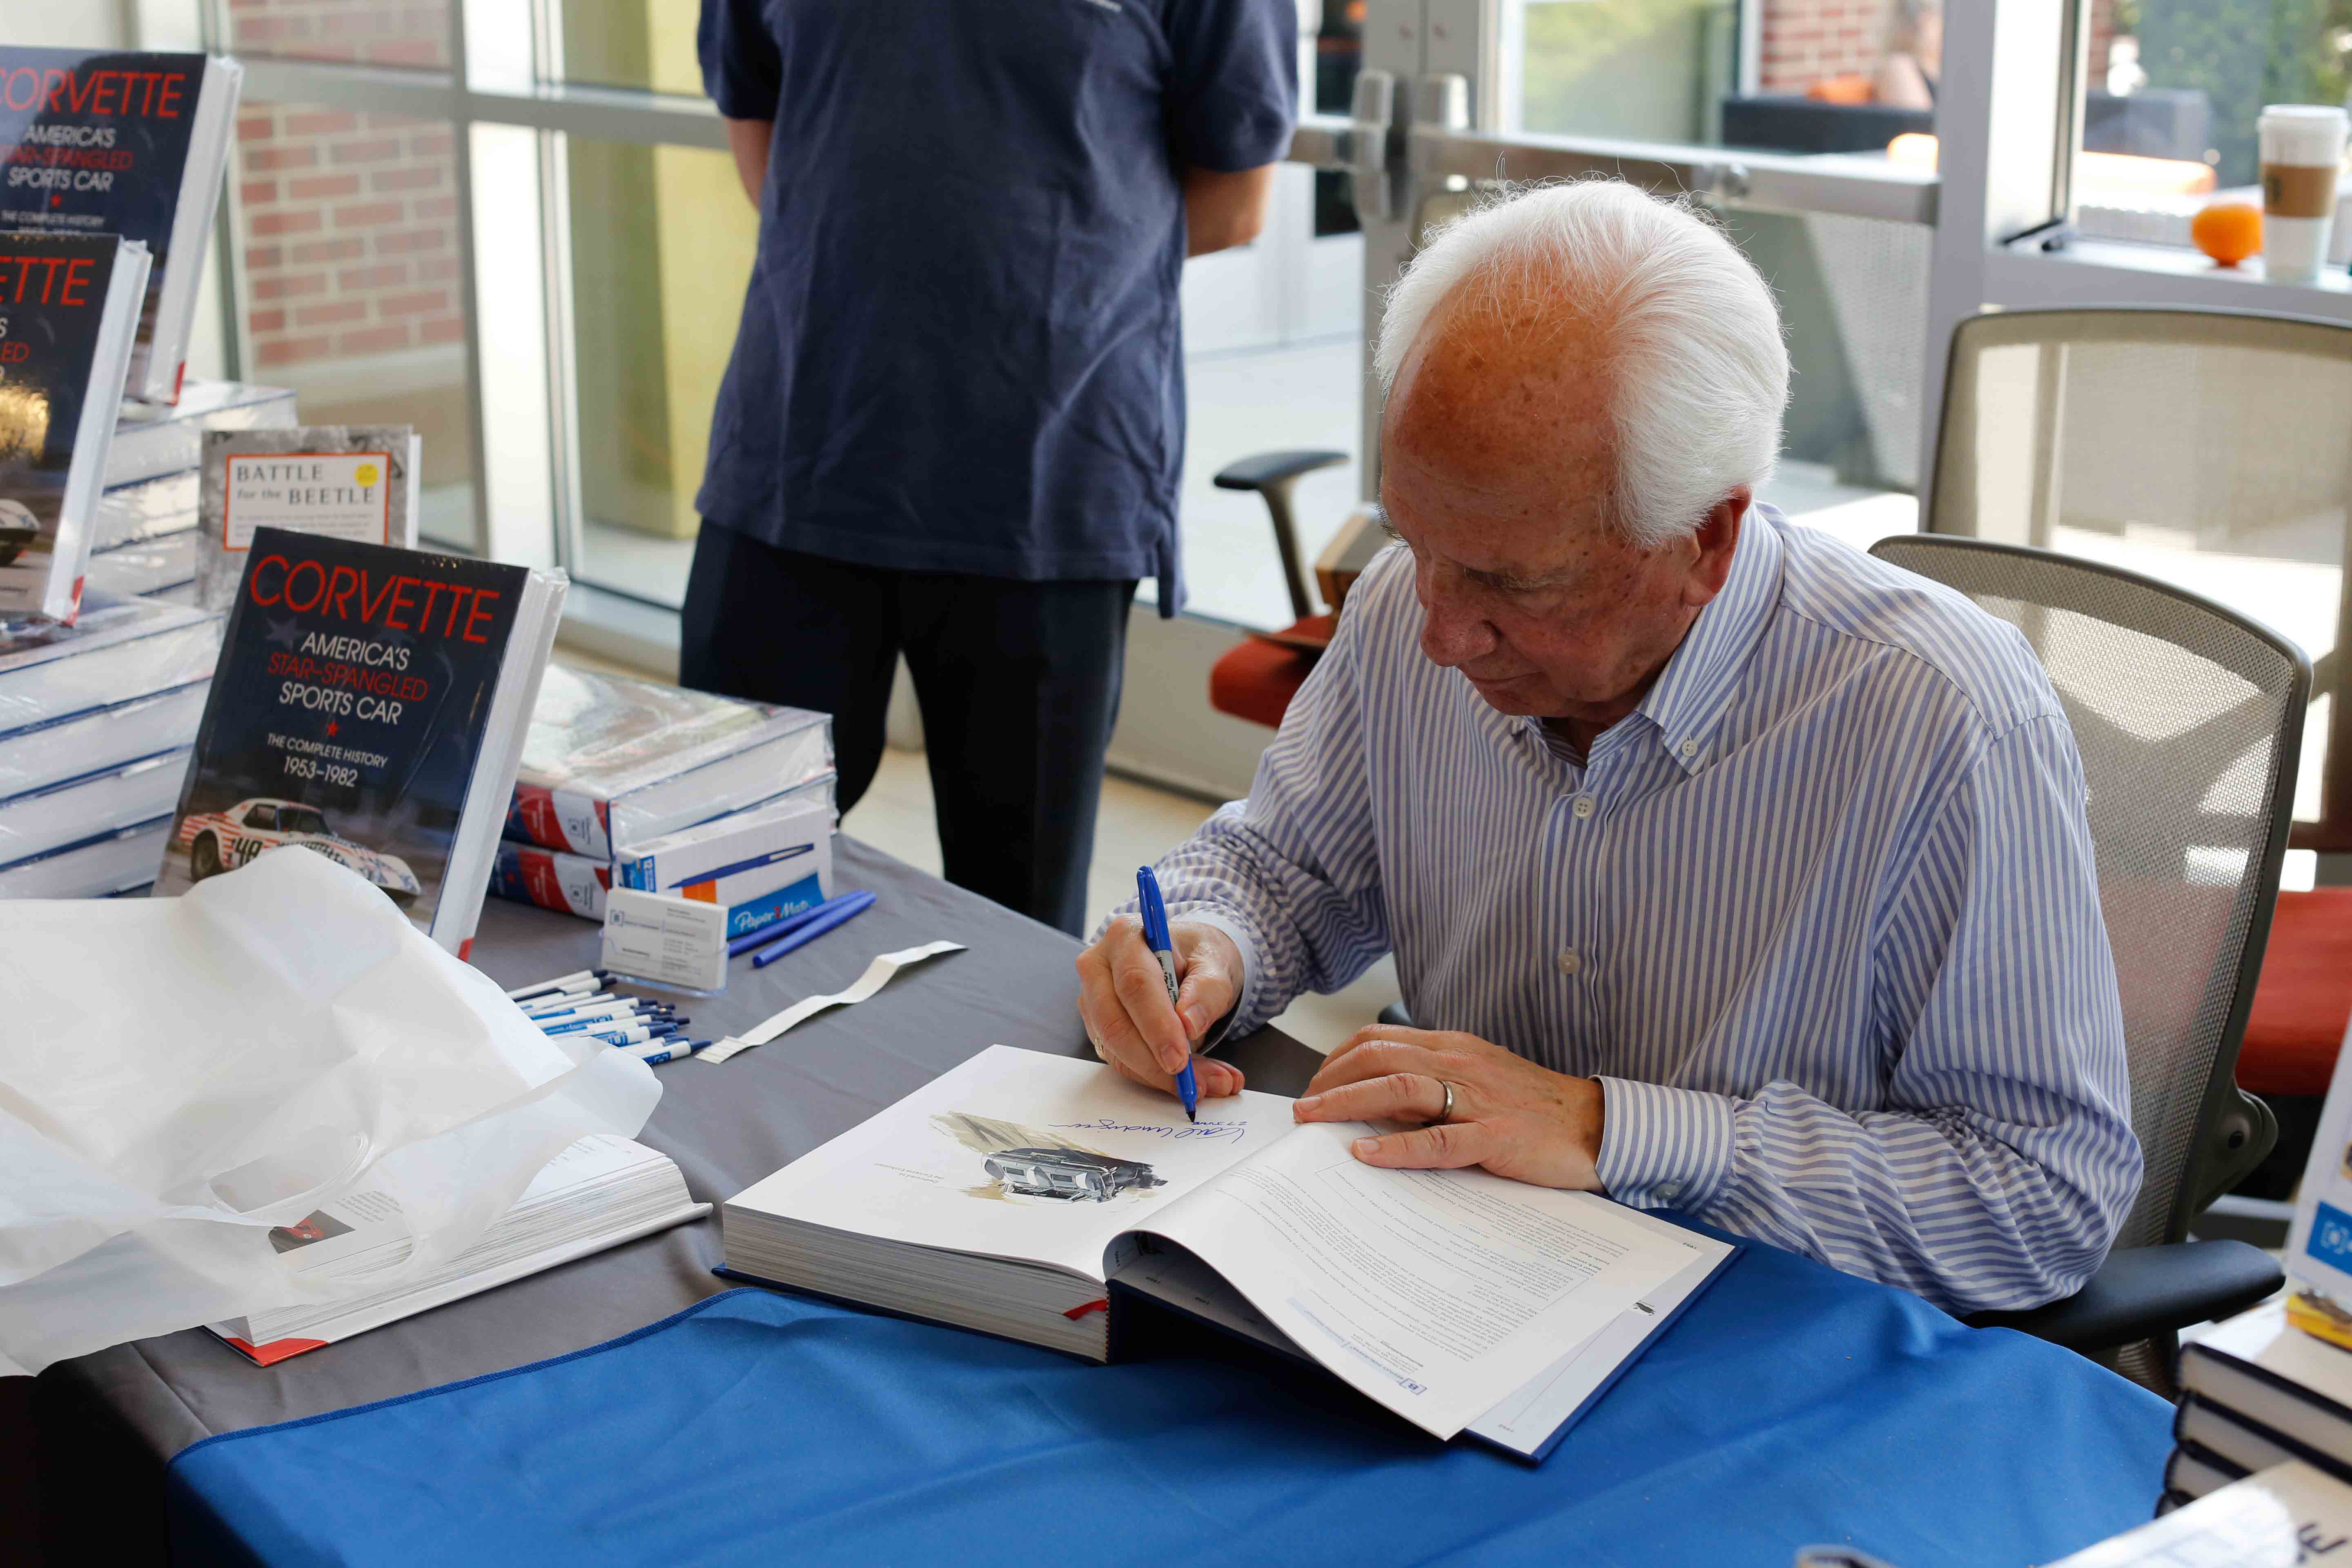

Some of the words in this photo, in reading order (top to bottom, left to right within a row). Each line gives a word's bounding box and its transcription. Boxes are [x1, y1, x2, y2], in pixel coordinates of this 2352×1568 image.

[24, 124, 117, 148] AMERICA'S
[0, 145, 134, 170] TAR-SPANGLED
[7, 166, 72, 190] SPORTS
[74, 170, 114, 192] CAR
[236, 464, 323, 482] BATTLE
[236, 488, 256, 499] for
[261, 488, 281, 499] the
[289, 486, 374, 505] BEETLE
[250, 554, 500, 644] CORVETTE
[300, 632, 411, 670] AMERICA'S
[279, 681, 354, 716] SPORTS
[356, 696, 403, 725] CAR
[267, 733, 287, 749] THE
[287, 737, 343, 761] COMPLETE
[343, 748, 389, 768] HISTORY
[734, 911, 775, 932] Paper
[906, 1169, 933, 1178] Corvette
[906, 1173, 939, 1184] Dedicated
